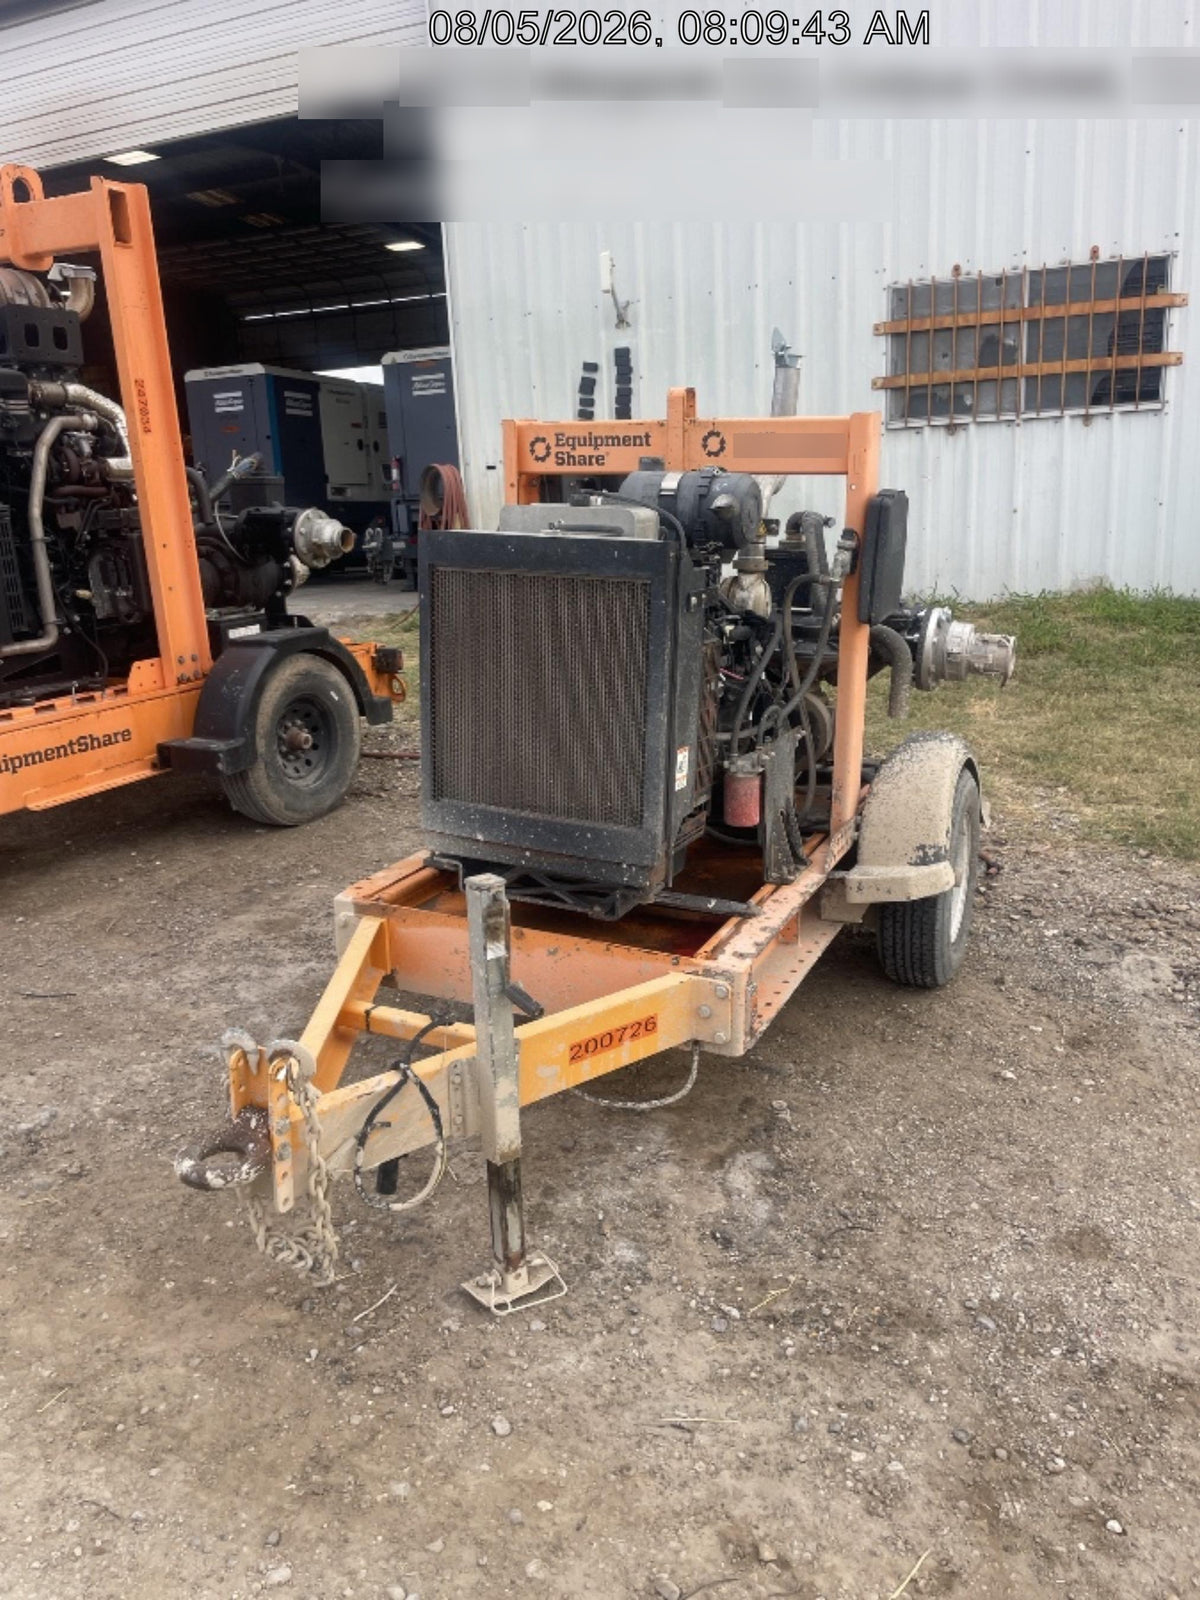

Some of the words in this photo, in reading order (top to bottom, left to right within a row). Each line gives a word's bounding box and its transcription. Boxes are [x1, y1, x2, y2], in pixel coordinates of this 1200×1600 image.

[554, 432, 652, 451] Equipment
[554, 451, 605, 466] Share
[0, 728, 132, 775] ipmentShare
[569, 1016, 657, 1062] 200726
